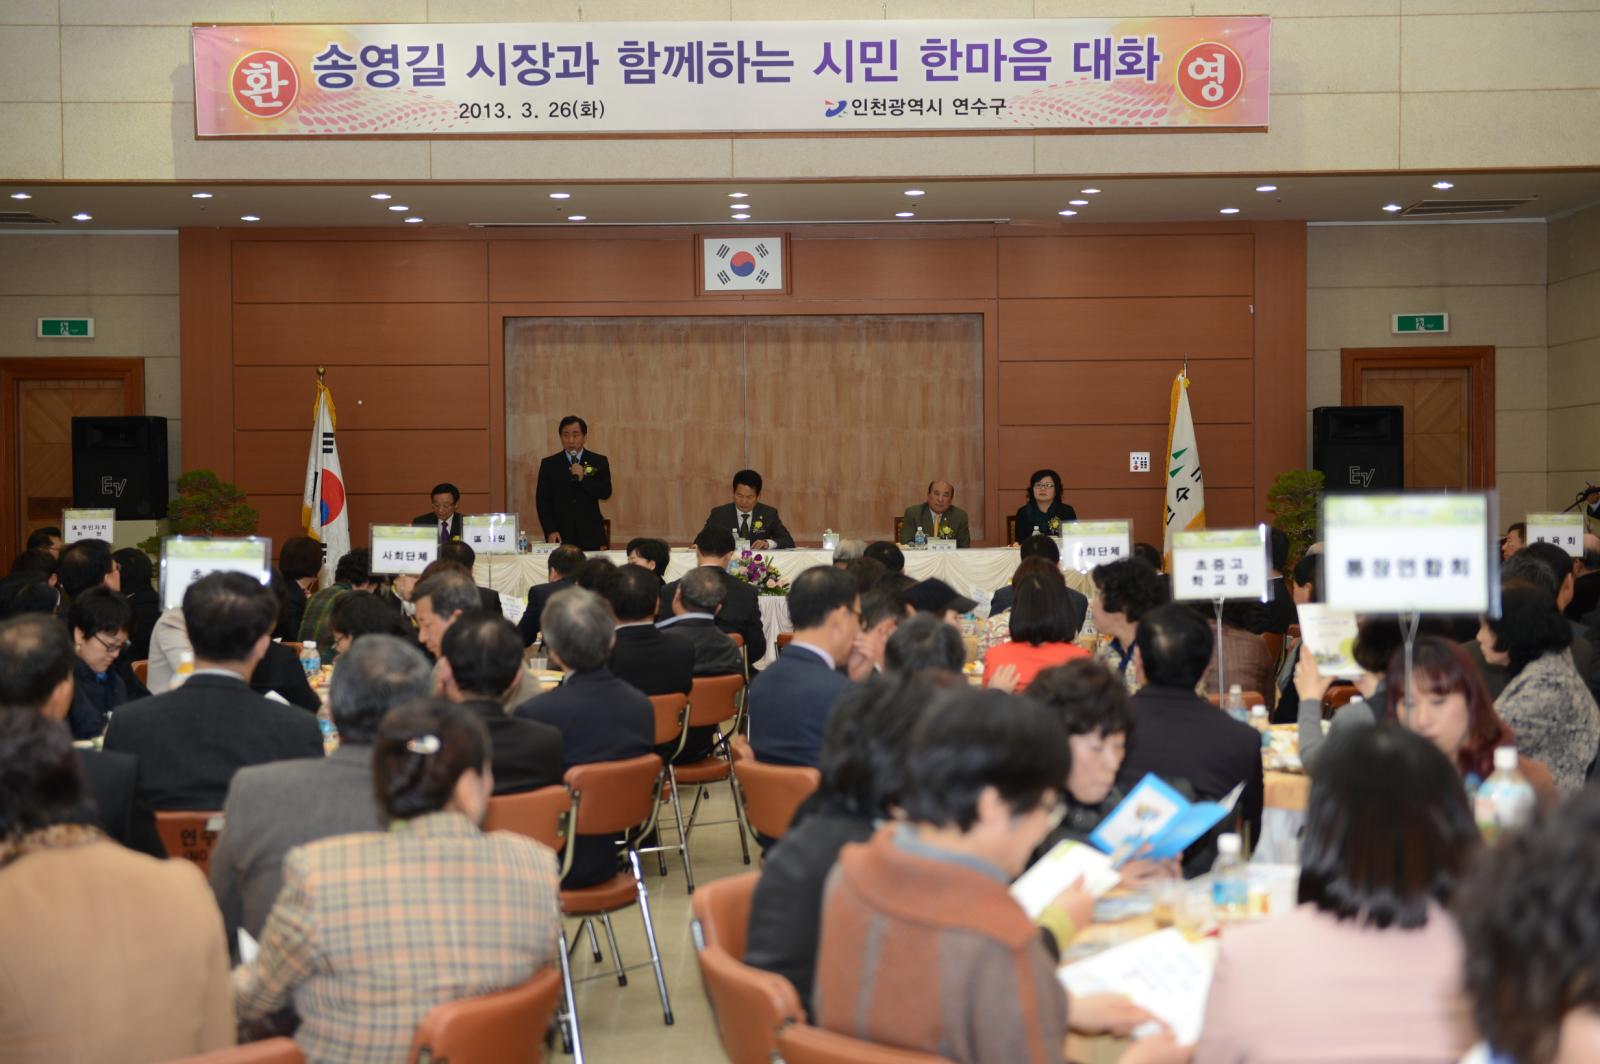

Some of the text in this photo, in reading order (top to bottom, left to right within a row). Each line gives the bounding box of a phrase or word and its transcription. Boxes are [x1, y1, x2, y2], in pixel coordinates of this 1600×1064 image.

[312, 36, 1161, 89] 송영길 시장과 함께하는 시민 한마음 대화
[240, 61, 289, 108] 환
[1186, 54, 1226, 102] 영
[459, 100, 606, 119] 2013. 3. 26(화)
[851, 97, 1008, 117] 인천광역시 연수구
[382, 550, 428, 562] 사회단체
[1195, 558, 1243, 571] 초중고
